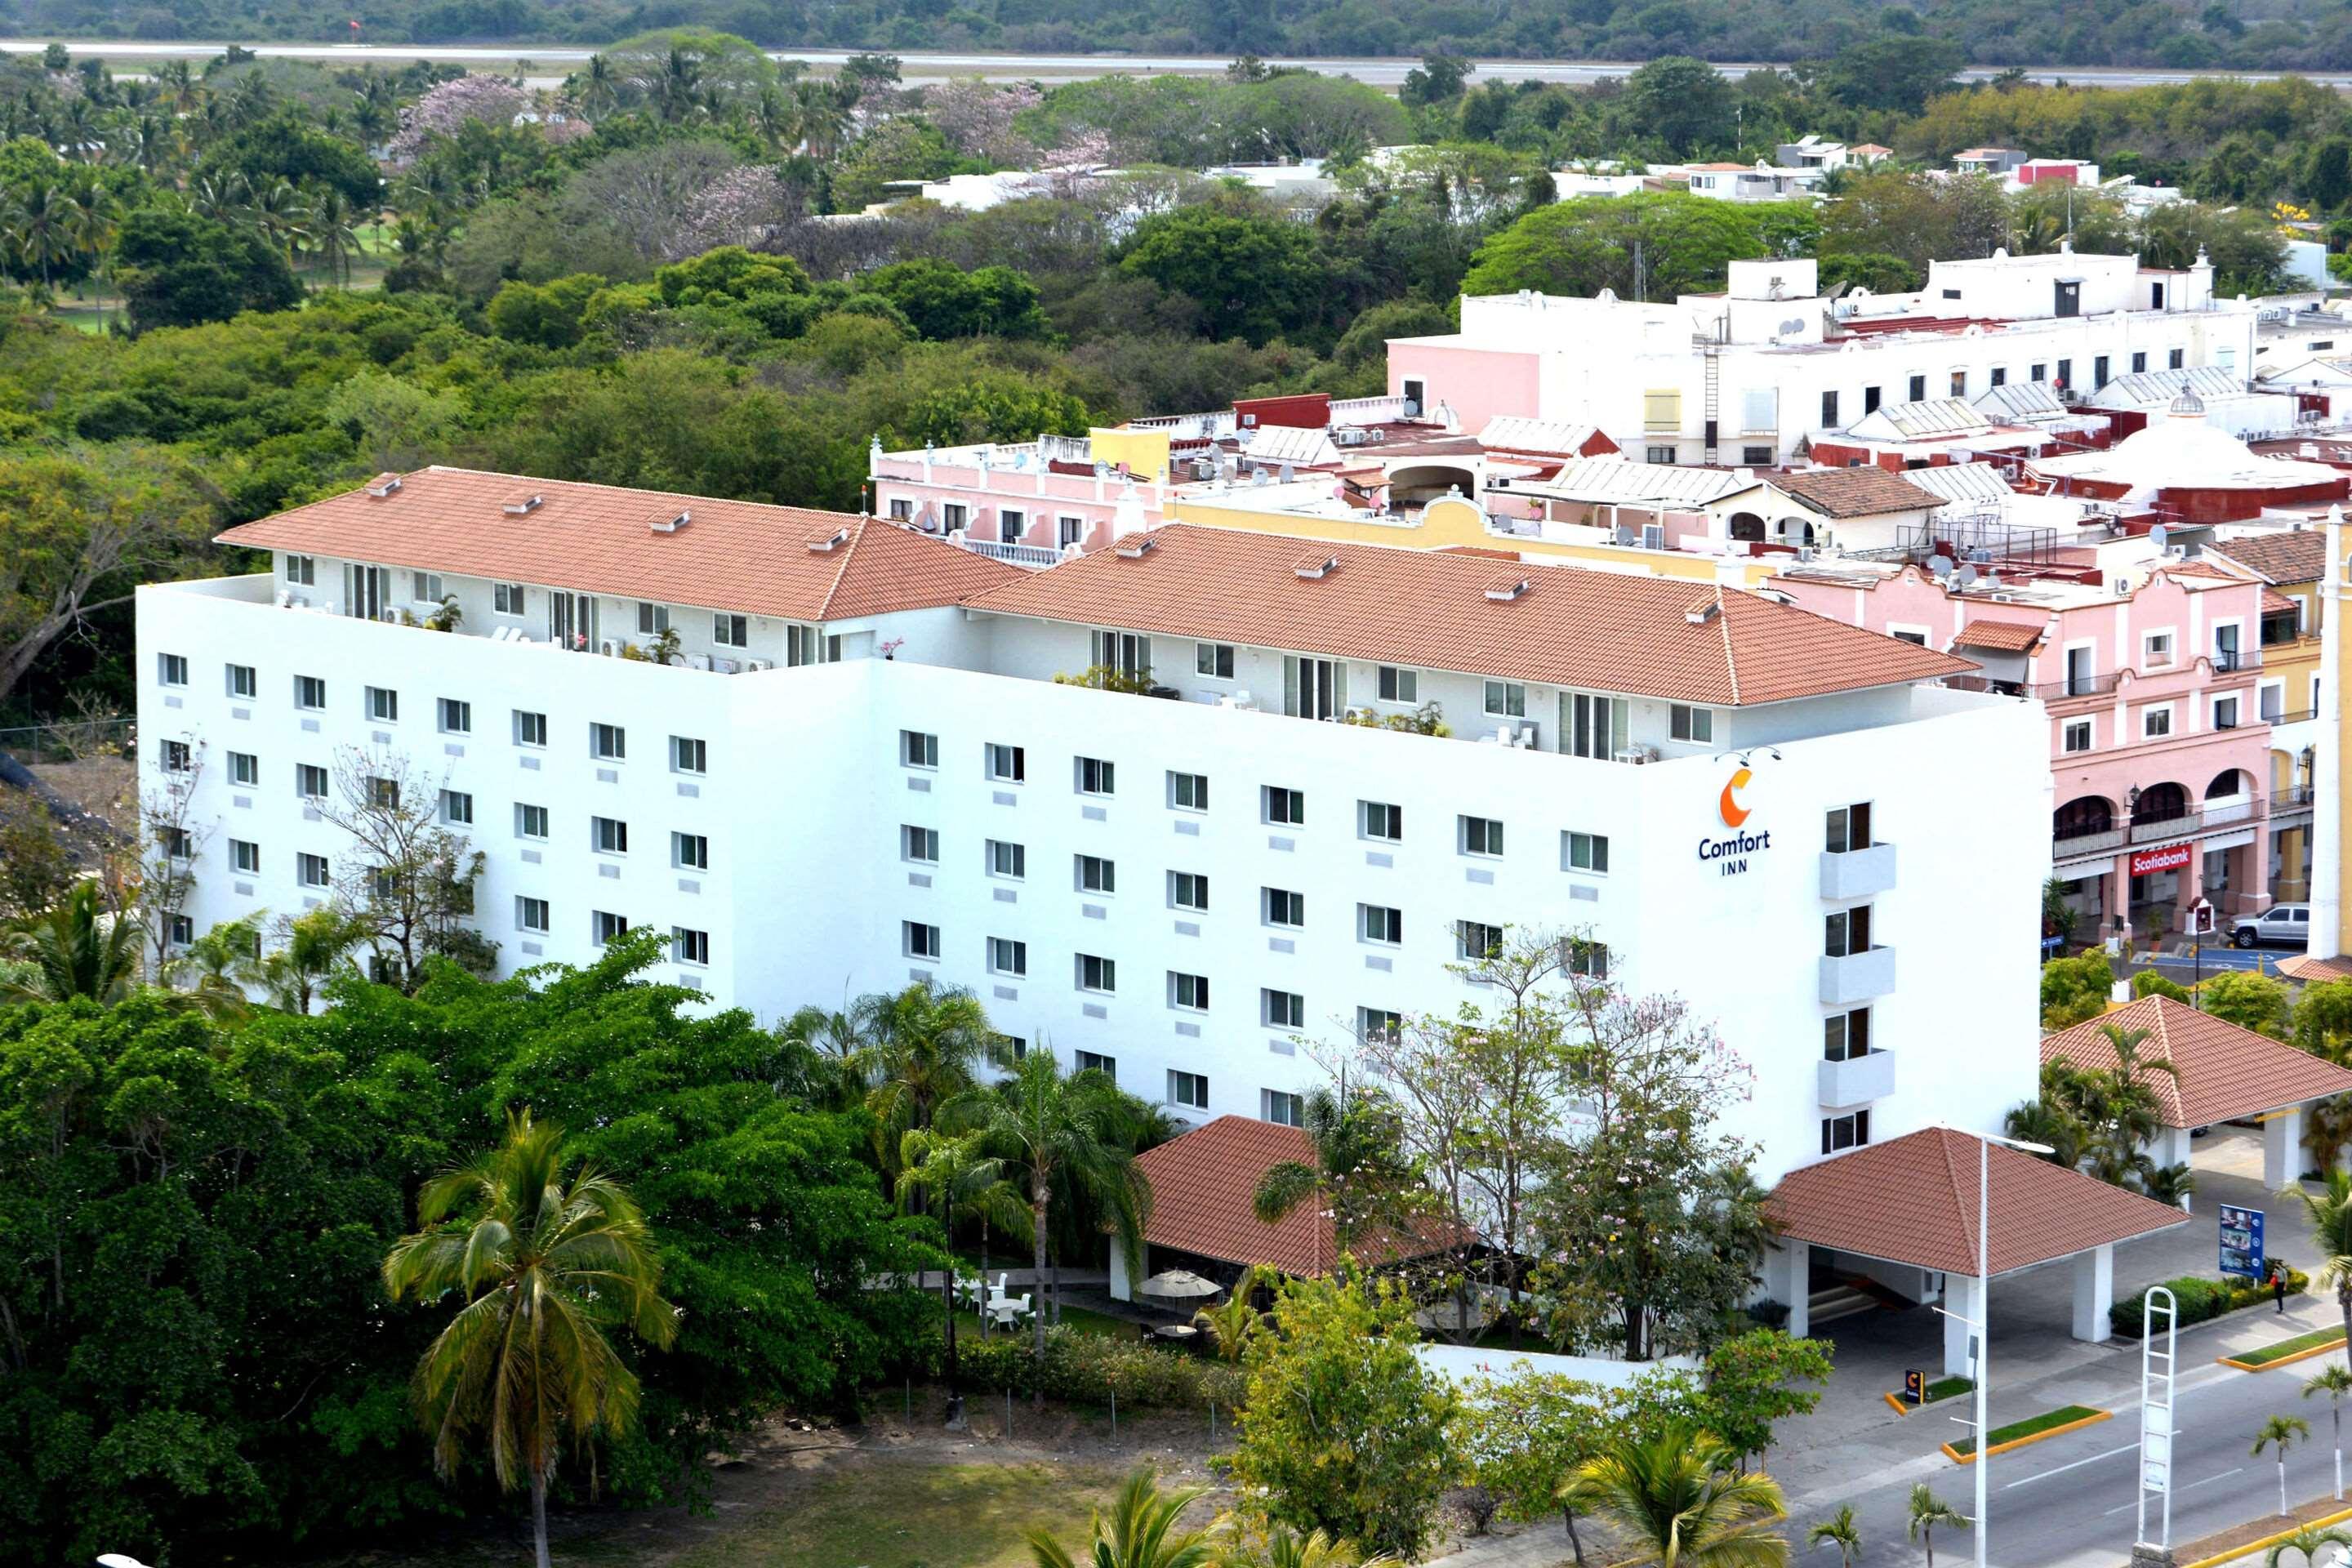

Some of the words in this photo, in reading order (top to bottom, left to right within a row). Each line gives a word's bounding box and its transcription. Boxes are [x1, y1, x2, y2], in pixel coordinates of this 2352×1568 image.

[1699, 830, 1771, 860] Comfort
[1722, 858, 1747, 876] INN
[2134, 849, 2189, 872] Scotiabank
